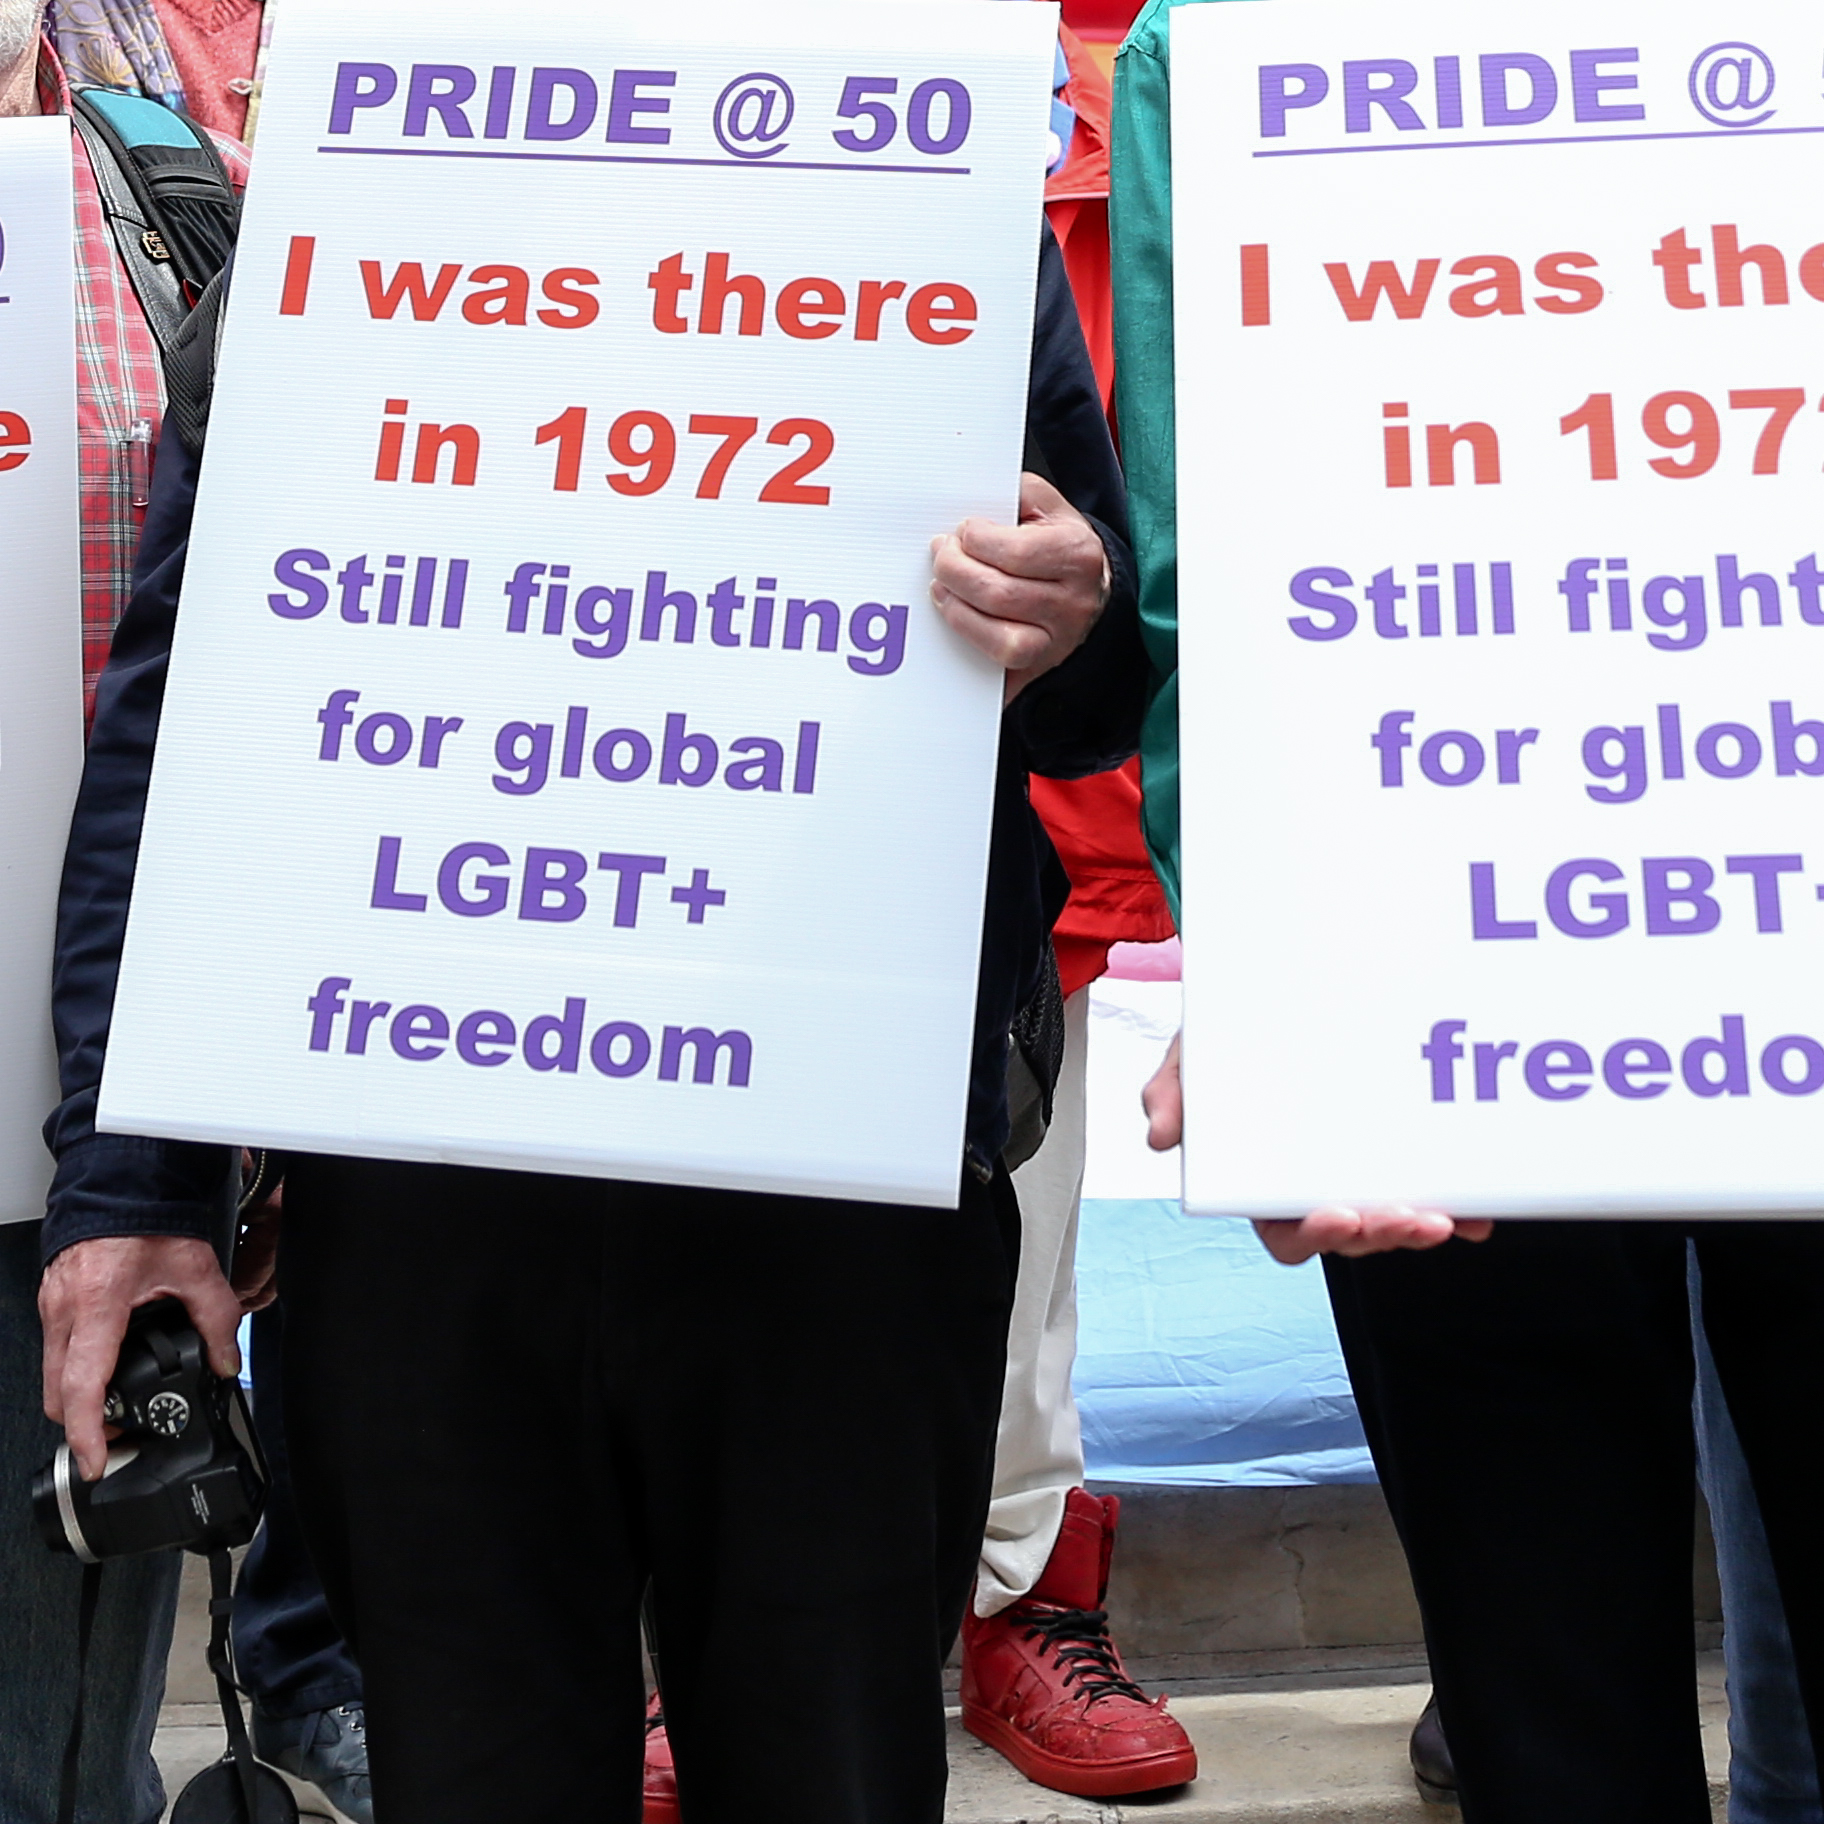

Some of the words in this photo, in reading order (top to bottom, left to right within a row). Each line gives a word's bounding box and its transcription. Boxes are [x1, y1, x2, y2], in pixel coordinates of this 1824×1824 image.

[328, 62, 676, 144] PRIDE
[714, 73, 794, 159] @
[833, 77, 971, 155] 50
[1260, 48, 1645, 137] PRIDE
[1690, 42, 1776, 128] @
[280, 236, 316, 315] I
[360, 260, 600, 329] was
[648, 252, 977, 345] there
[1241, 244, 1270, 326] I
[1324, 252, 1604, 321] was
[376, 399, 480, 486] in
[536, 406, 834, 505] 1972
[1384, 402, 1500, 488] in
[268, 548, 469, 628] Still
[504, 562, 909, 676] fighting
[1288, 562, 1515, 641] Still
[318, 689, 464, 768] for
[492, 706, 820, 795] global
[1372, 711, 1539, 787] for
[371, 836, 726, 928] LGBT+
[308, 977, 752, 1087] freedom
